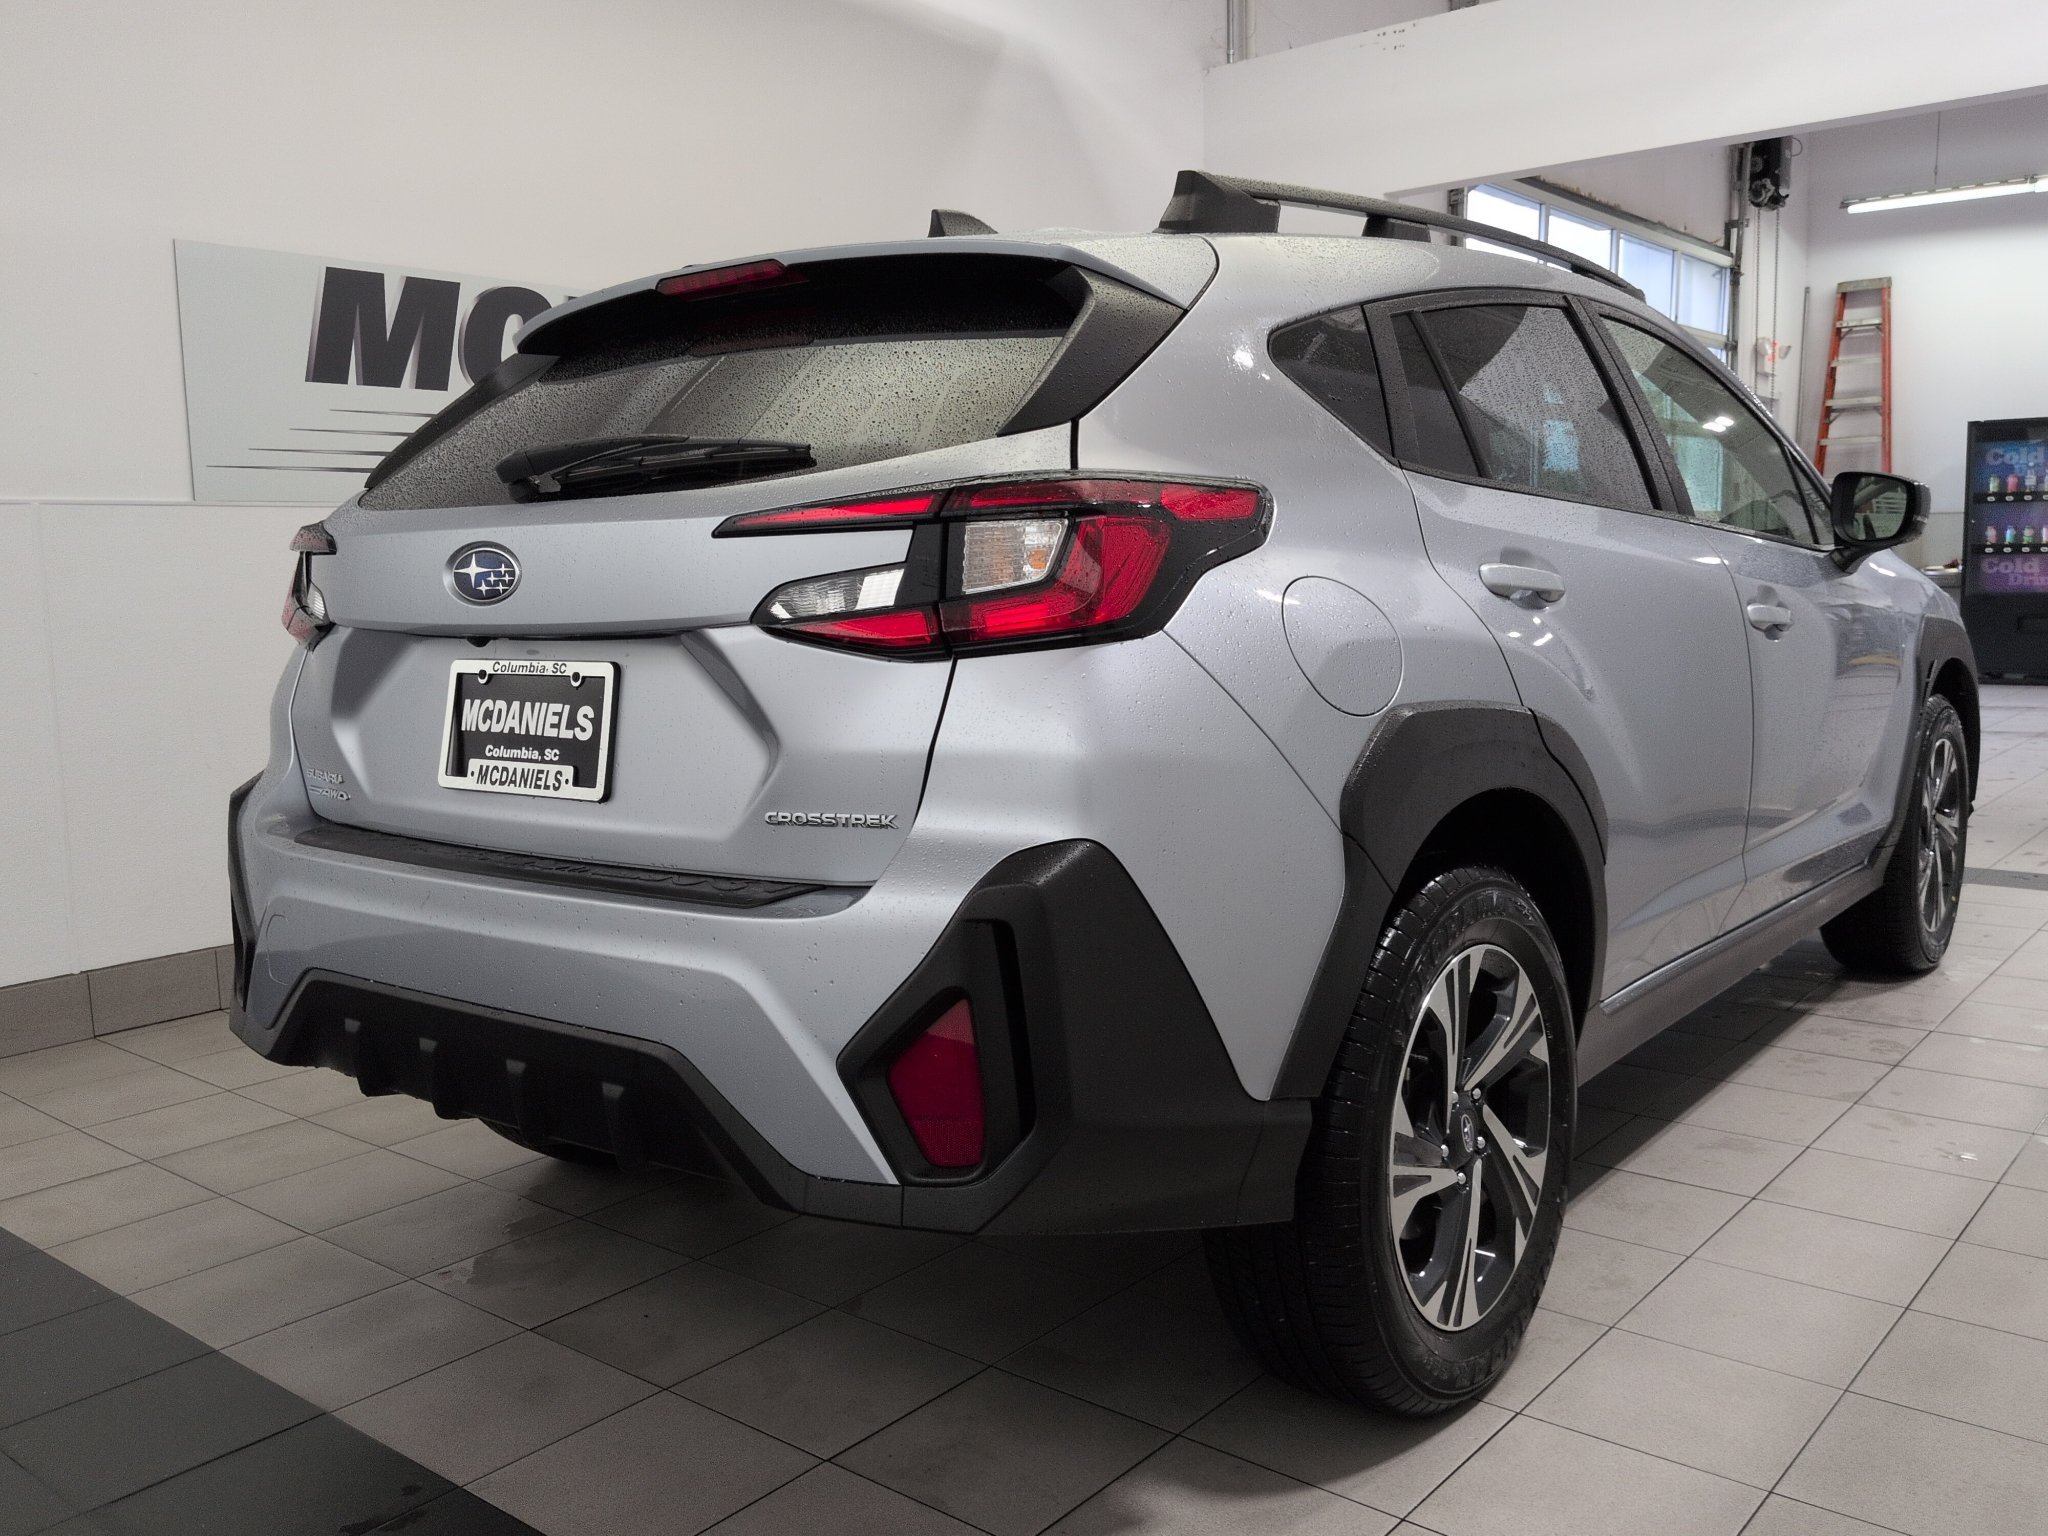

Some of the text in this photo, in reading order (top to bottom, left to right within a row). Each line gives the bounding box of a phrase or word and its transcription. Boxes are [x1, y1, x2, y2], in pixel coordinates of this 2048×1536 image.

[305, 266, 572, 392] MC
[1981, 557, 2040, 573] Cold
[551, 663, 568, 674] SC
[461, 699, 595, 741] MCDANIELS
[485, 744, 560, 761] Columbia, SC
[476, 764, 563, 792] MCDANIELS
[764, 811, 899, 830] CROSSTREK
